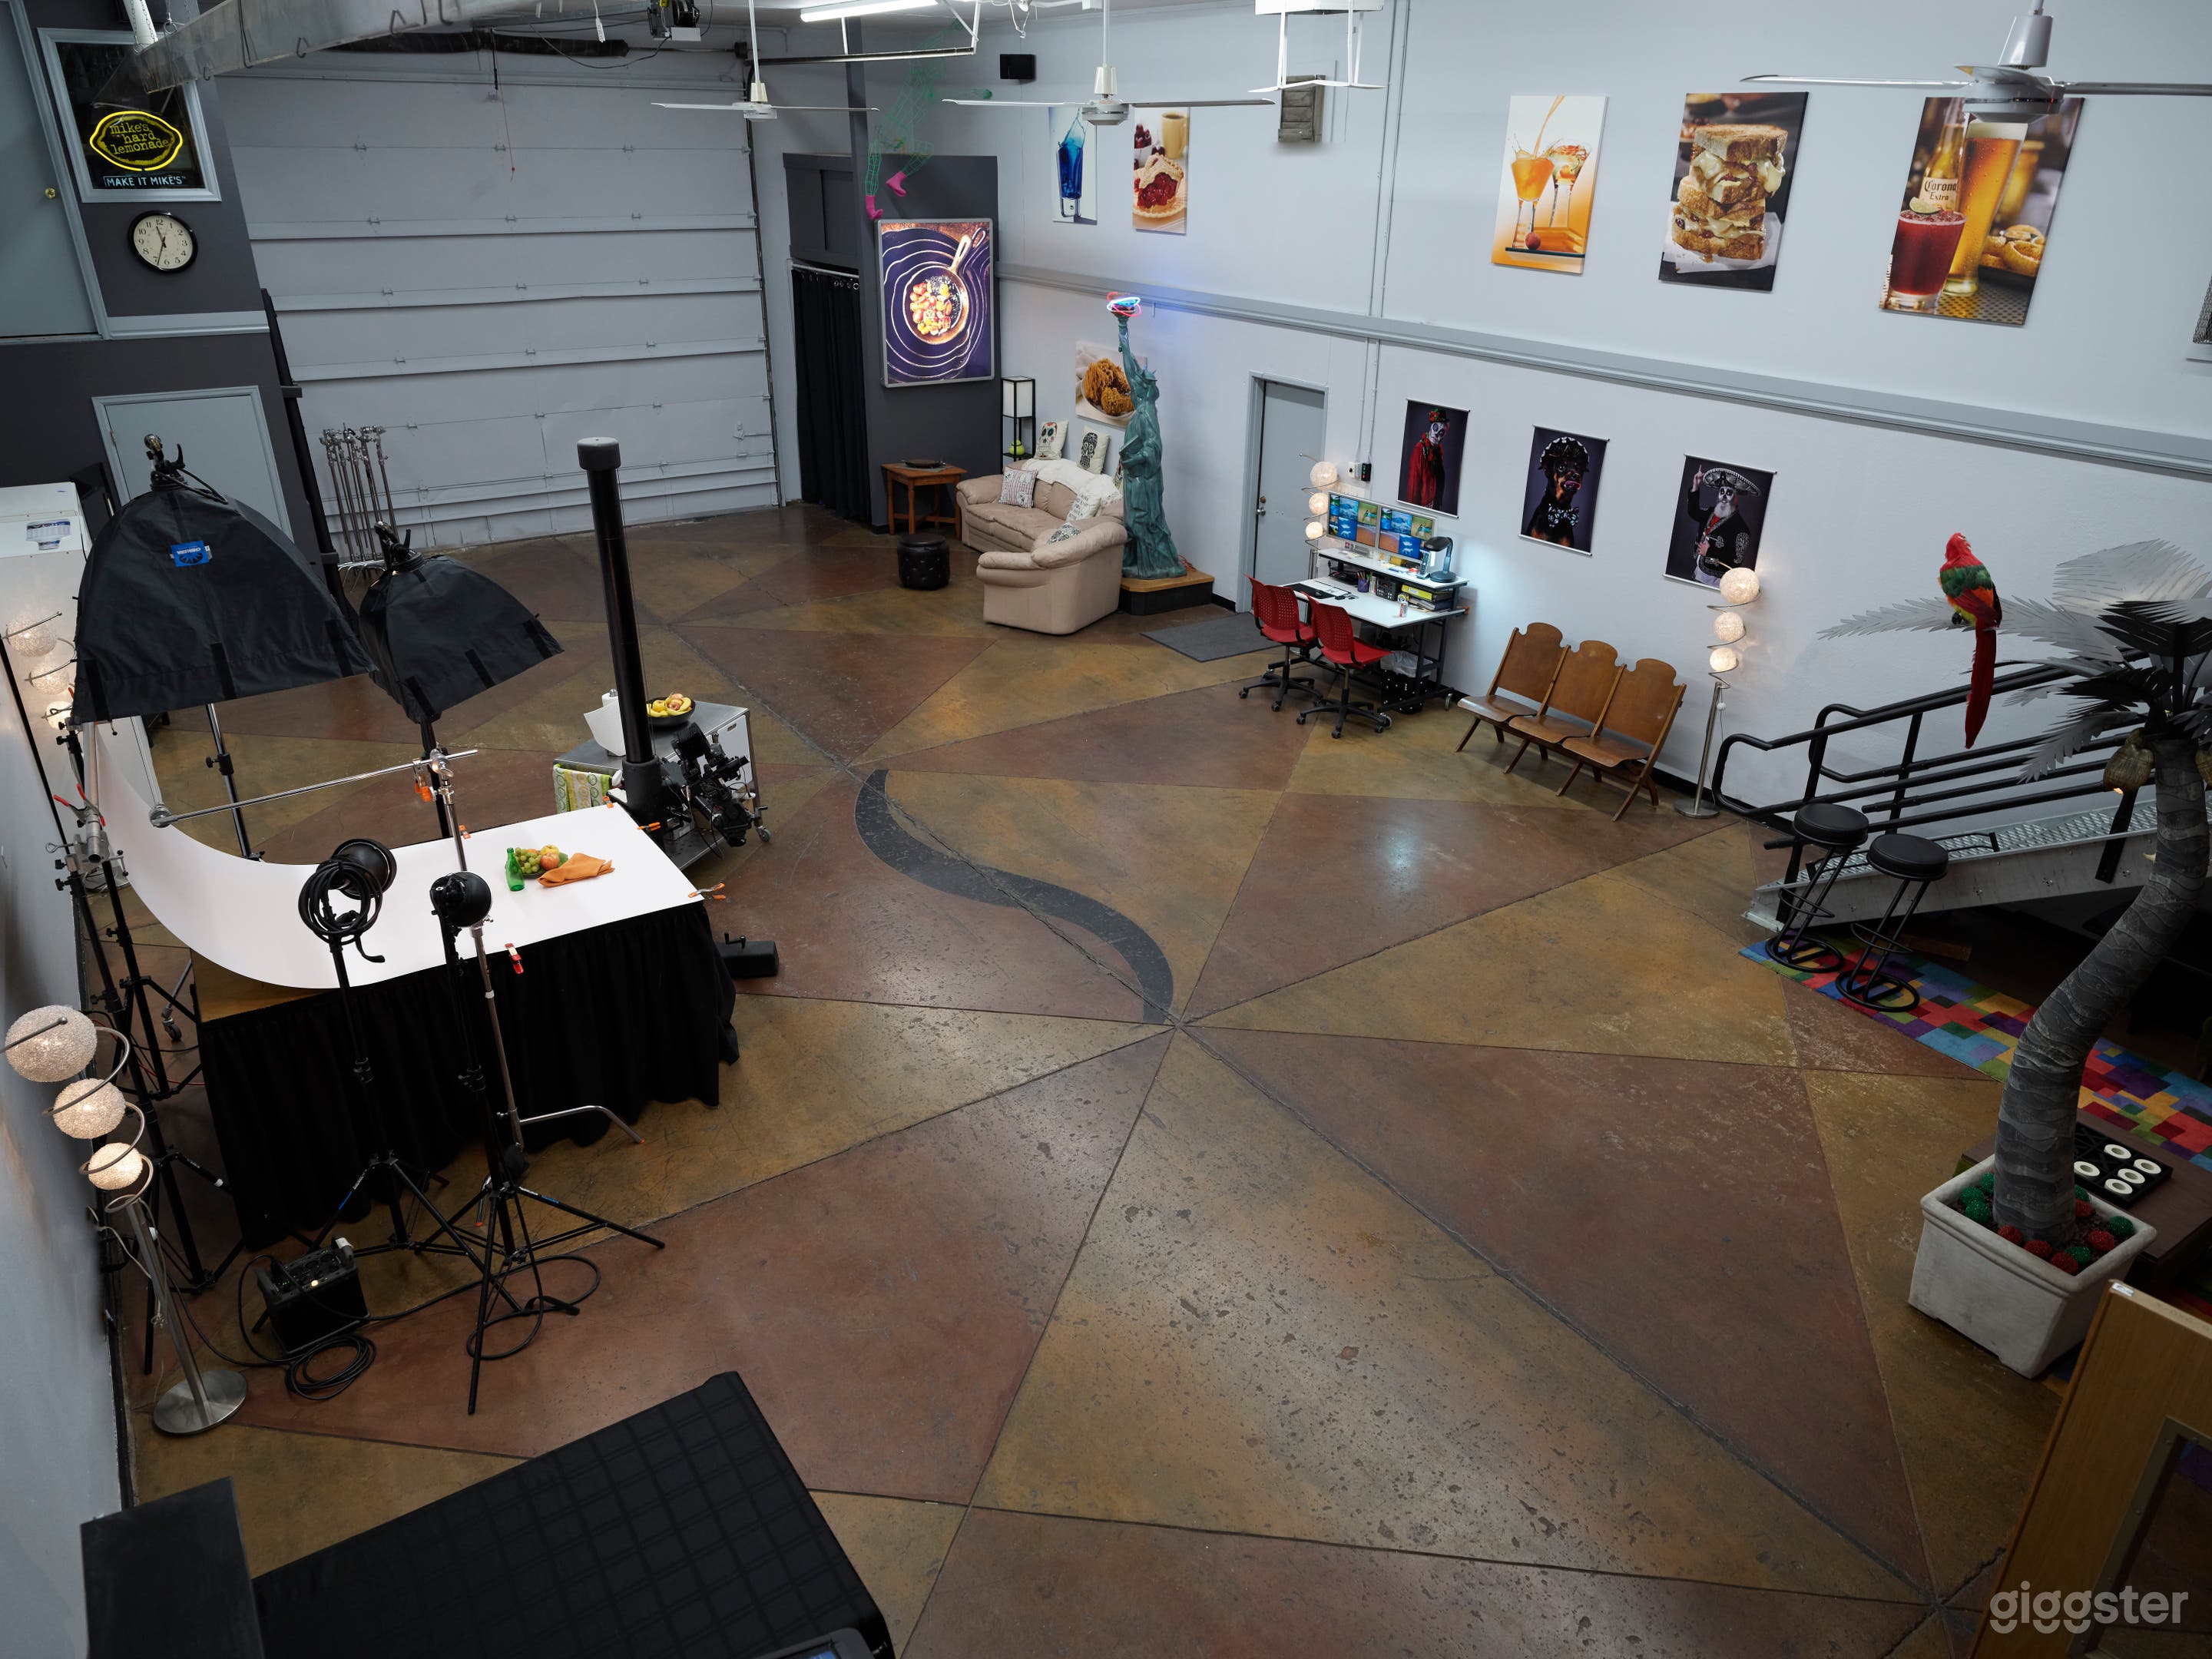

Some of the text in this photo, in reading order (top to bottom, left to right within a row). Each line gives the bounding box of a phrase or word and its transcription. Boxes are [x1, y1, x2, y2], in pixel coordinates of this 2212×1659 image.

[109, 122, 150, 134] mike's
[122, 130, 157, 144] hard
[110, 138, 169, 155] lemonade
[106, 177, 135, 187] MAKE
[137, 177, 147, 186] IT
[1924, 180, 1958, 192] Corona
[1929, 191, 1949, 200] Extra
